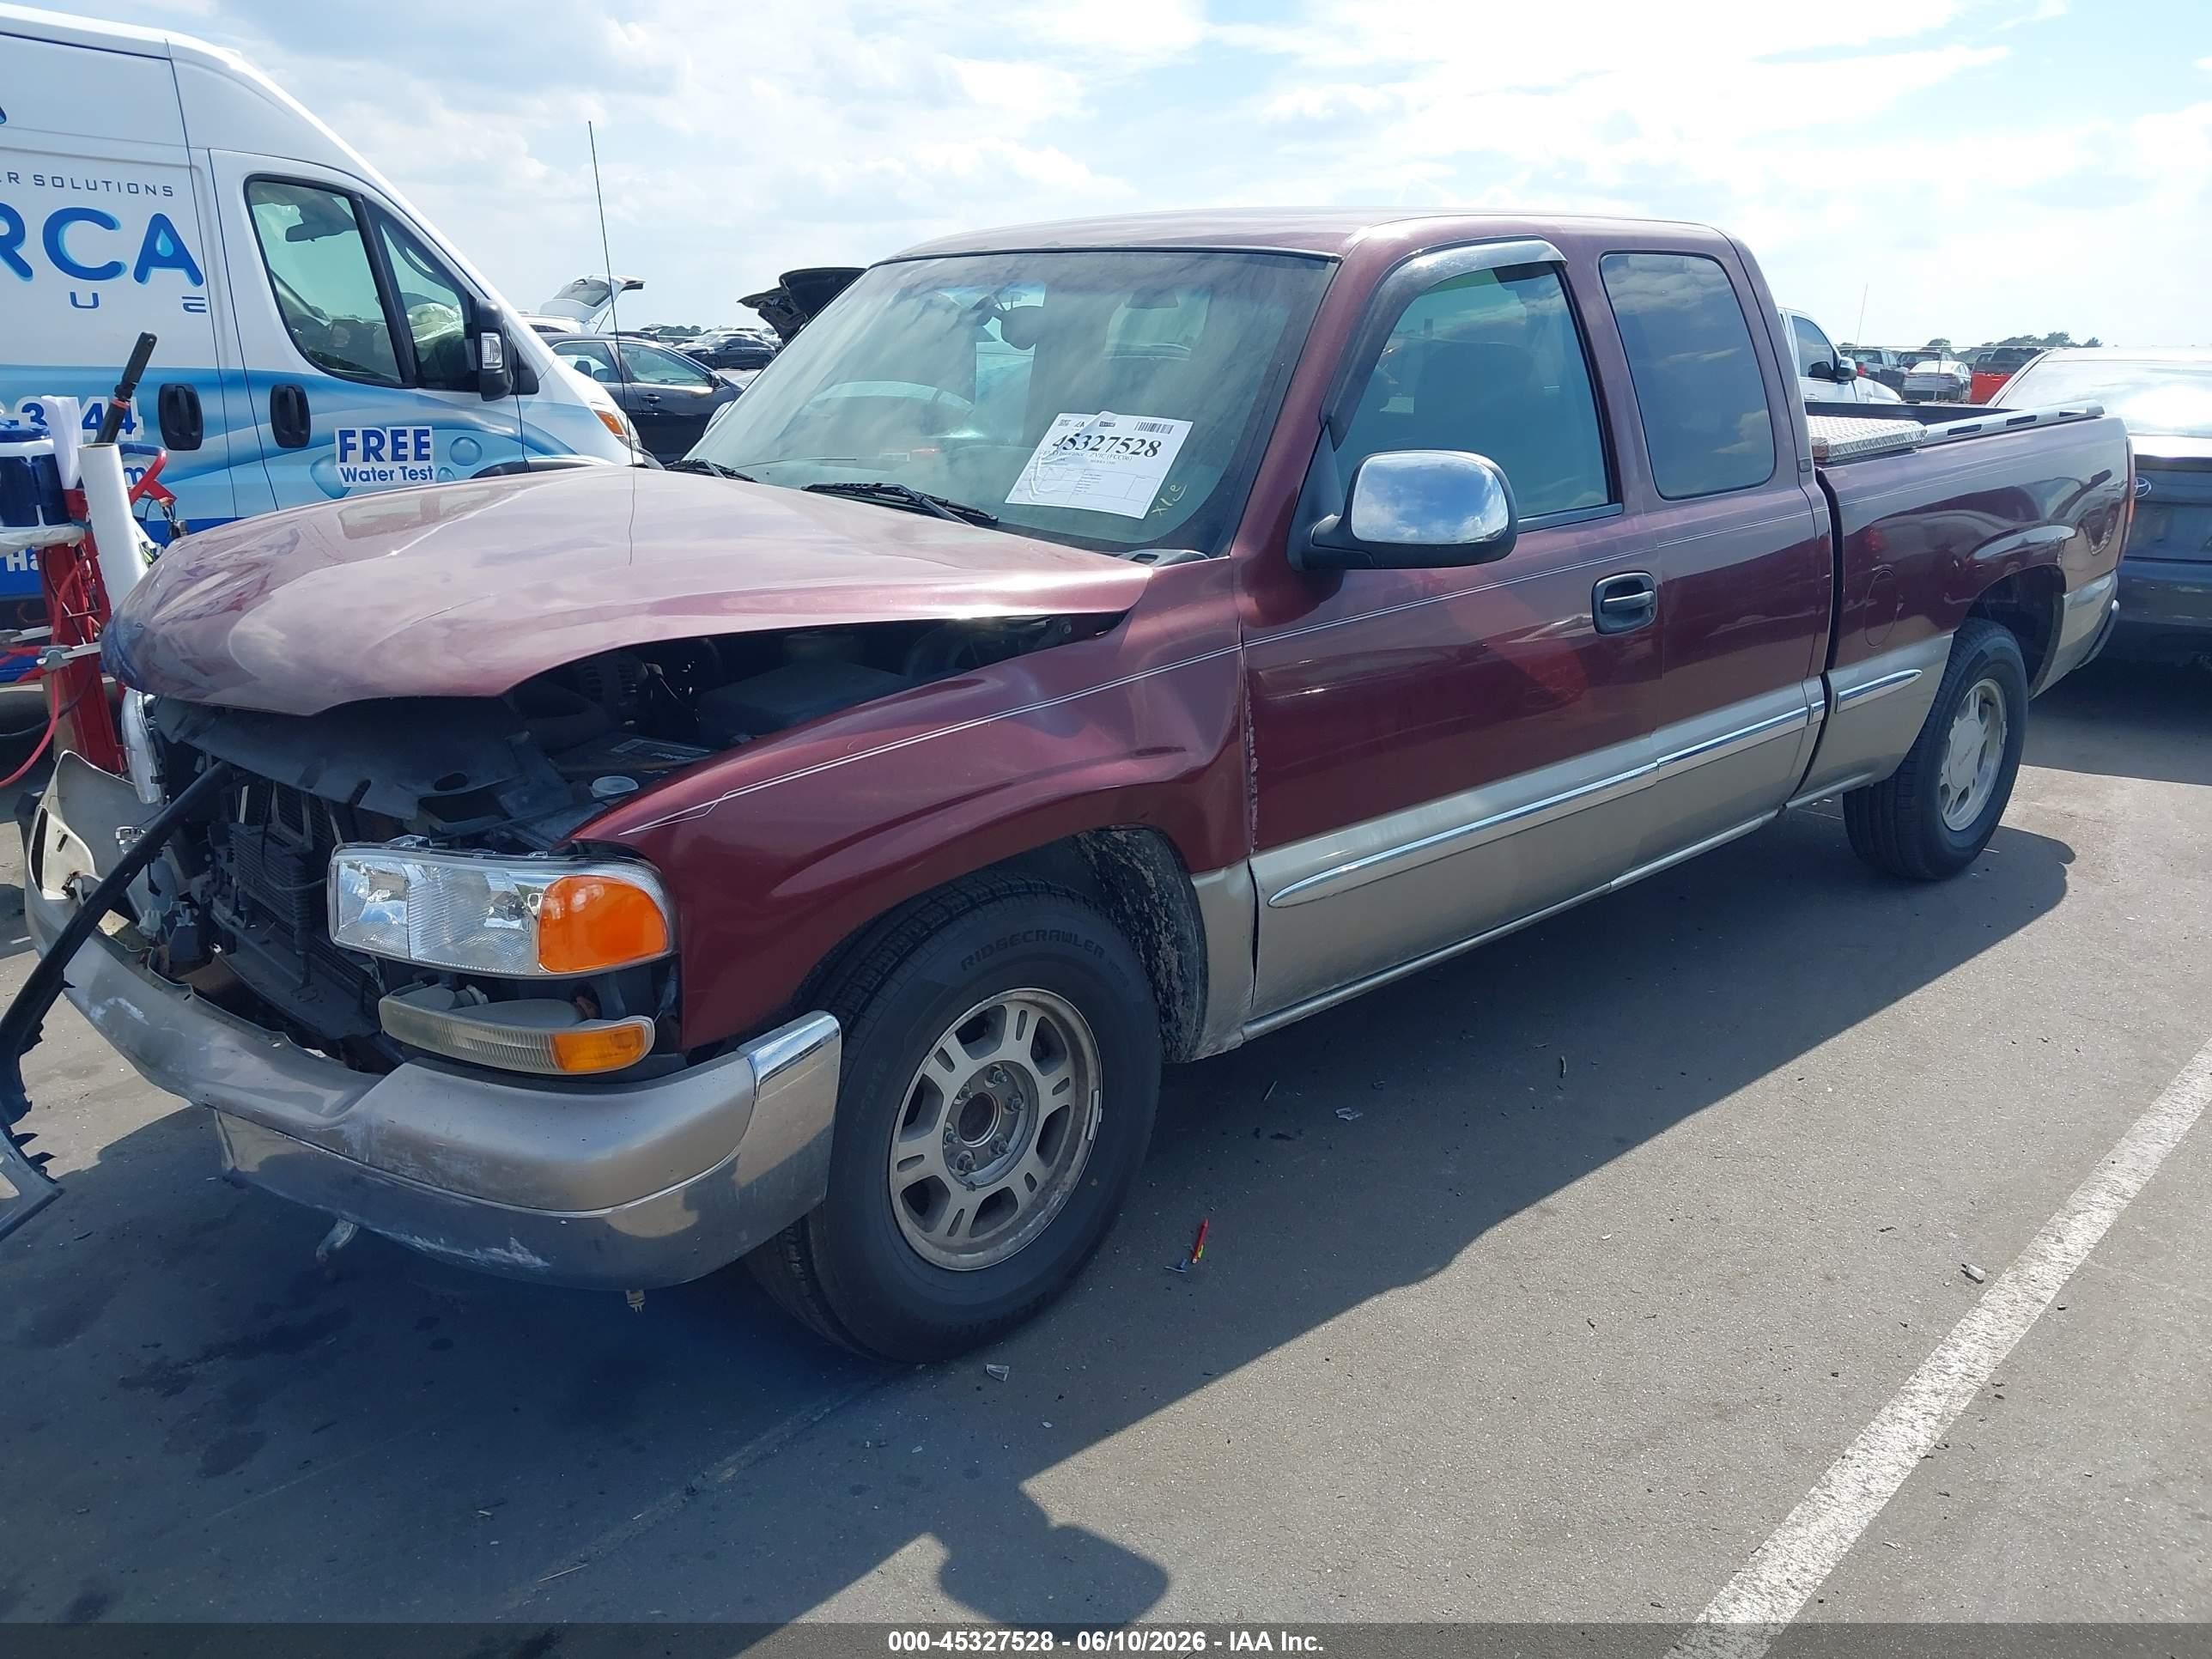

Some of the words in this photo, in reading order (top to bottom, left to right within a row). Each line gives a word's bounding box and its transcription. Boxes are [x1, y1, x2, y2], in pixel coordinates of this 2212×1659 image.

[33, 174, 173, 197] SOLUTIONS
[338, 429, 431, 463] FREE
[1052, 433, 1162, 458] 45327528
[339, 466, 395, 483] Water
[398, 465, 434, 481] Test
[961, 928, 1106, 971] RIDGECRAWLER
